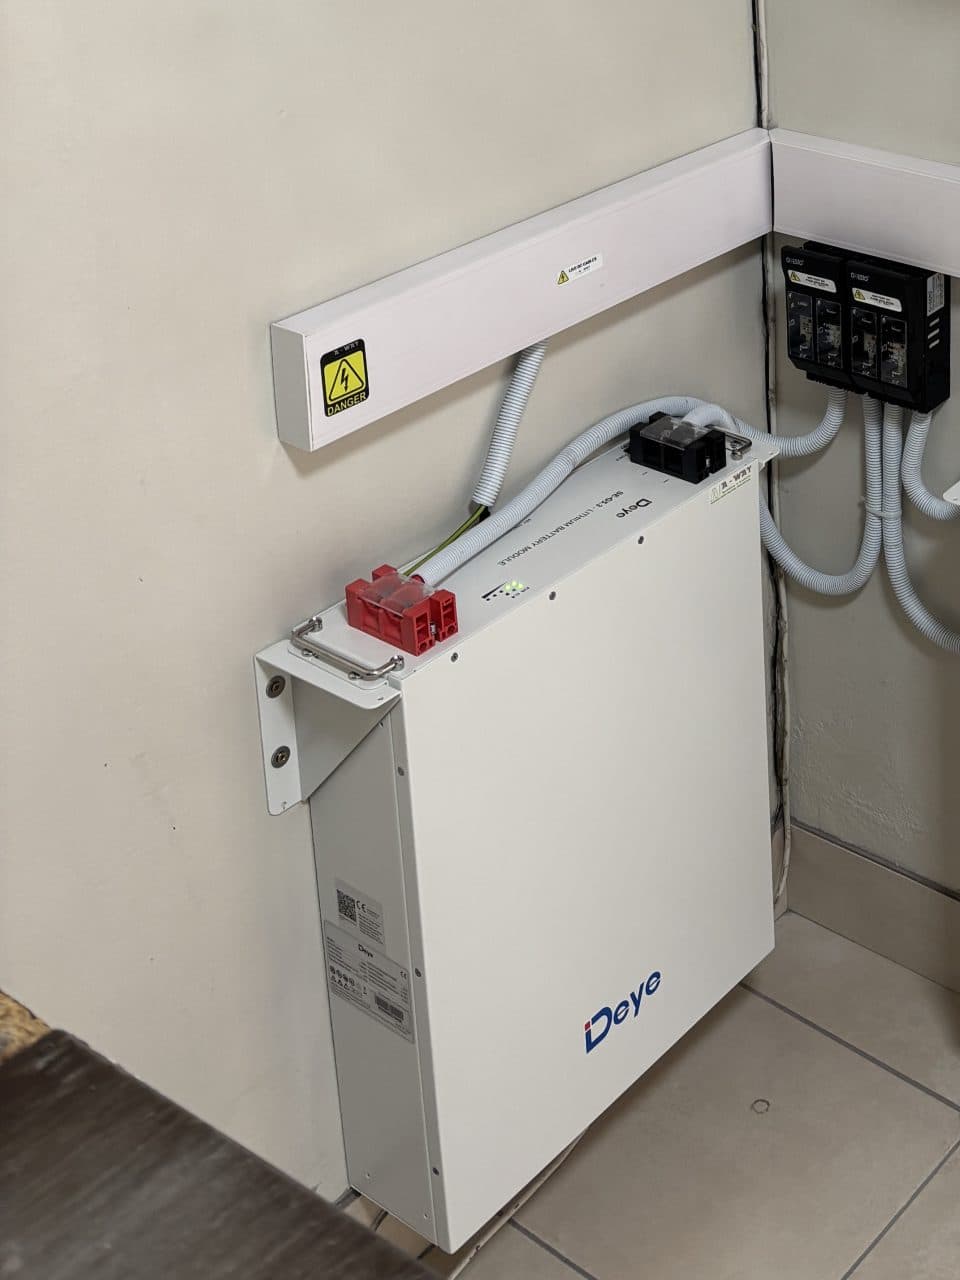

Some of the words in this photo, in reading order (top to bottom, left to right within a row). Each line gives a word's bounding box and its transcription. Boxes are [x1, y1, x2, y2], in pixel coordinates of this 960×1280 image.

[327, 392, 366, 416] DANGER
[564, 508, 594, 527] LITHIUM
[532, 526, 565, 548] BATTERY
[497, 546, 532, 566] MODULE
[583, 971, 661, 1055] Deye
